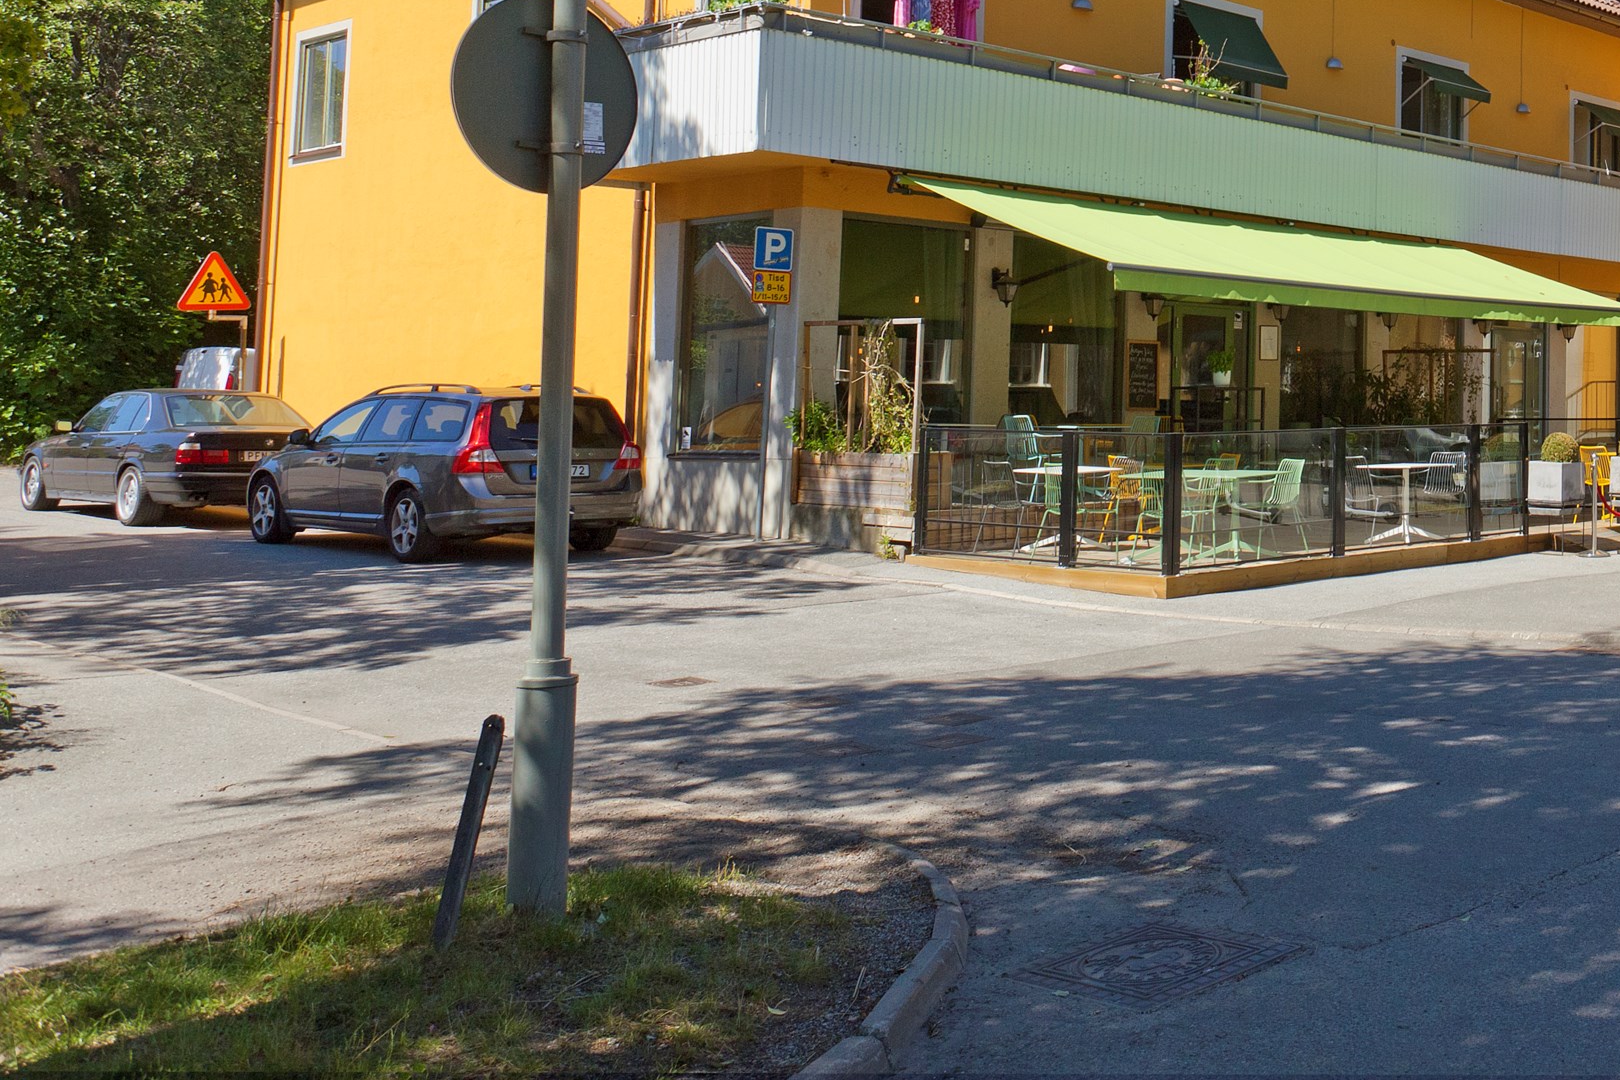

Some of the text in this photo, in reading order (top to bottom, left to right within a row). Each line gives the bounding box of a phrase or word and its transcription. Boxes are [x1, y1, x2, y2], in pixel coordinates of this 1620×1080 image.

[764, 232, 787, 262] P
[768, 273, 785, 282] Tisd
[767, 283, 785, 292] 8-16
